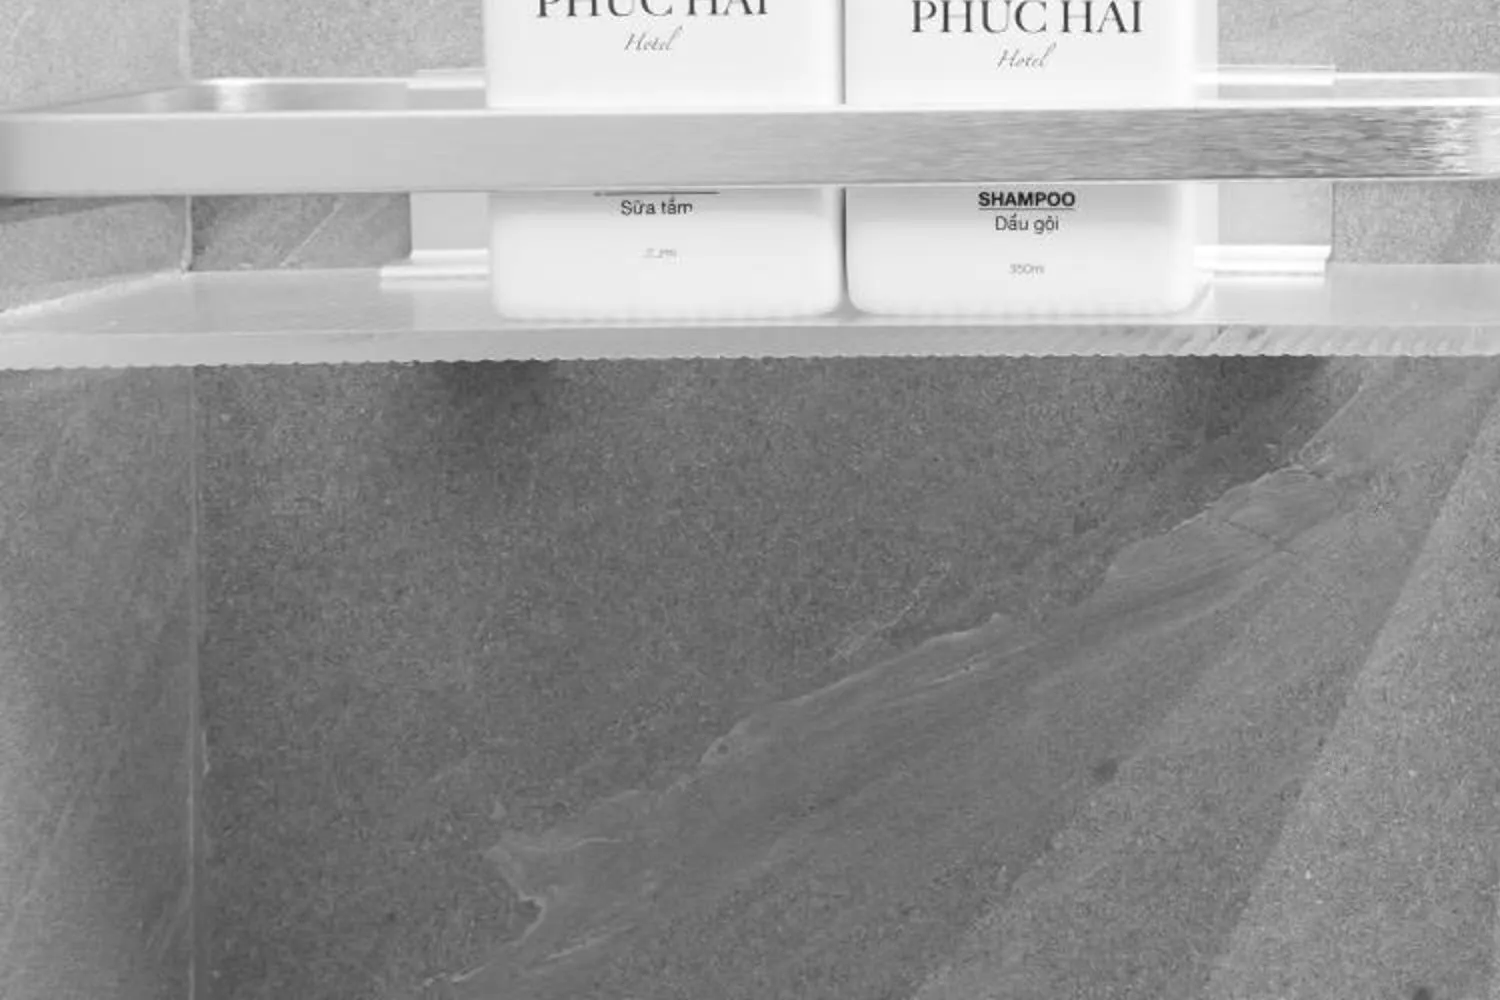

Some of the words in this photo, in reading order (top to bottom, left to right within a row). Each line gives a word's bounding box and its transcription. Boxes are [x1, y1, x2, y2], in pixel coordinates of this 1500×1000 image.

[623, 25, 683, 51] Hotel
[997, 41, 1057, 68] Hotel
[978, 191, 1076, 207] SHAMPOO
